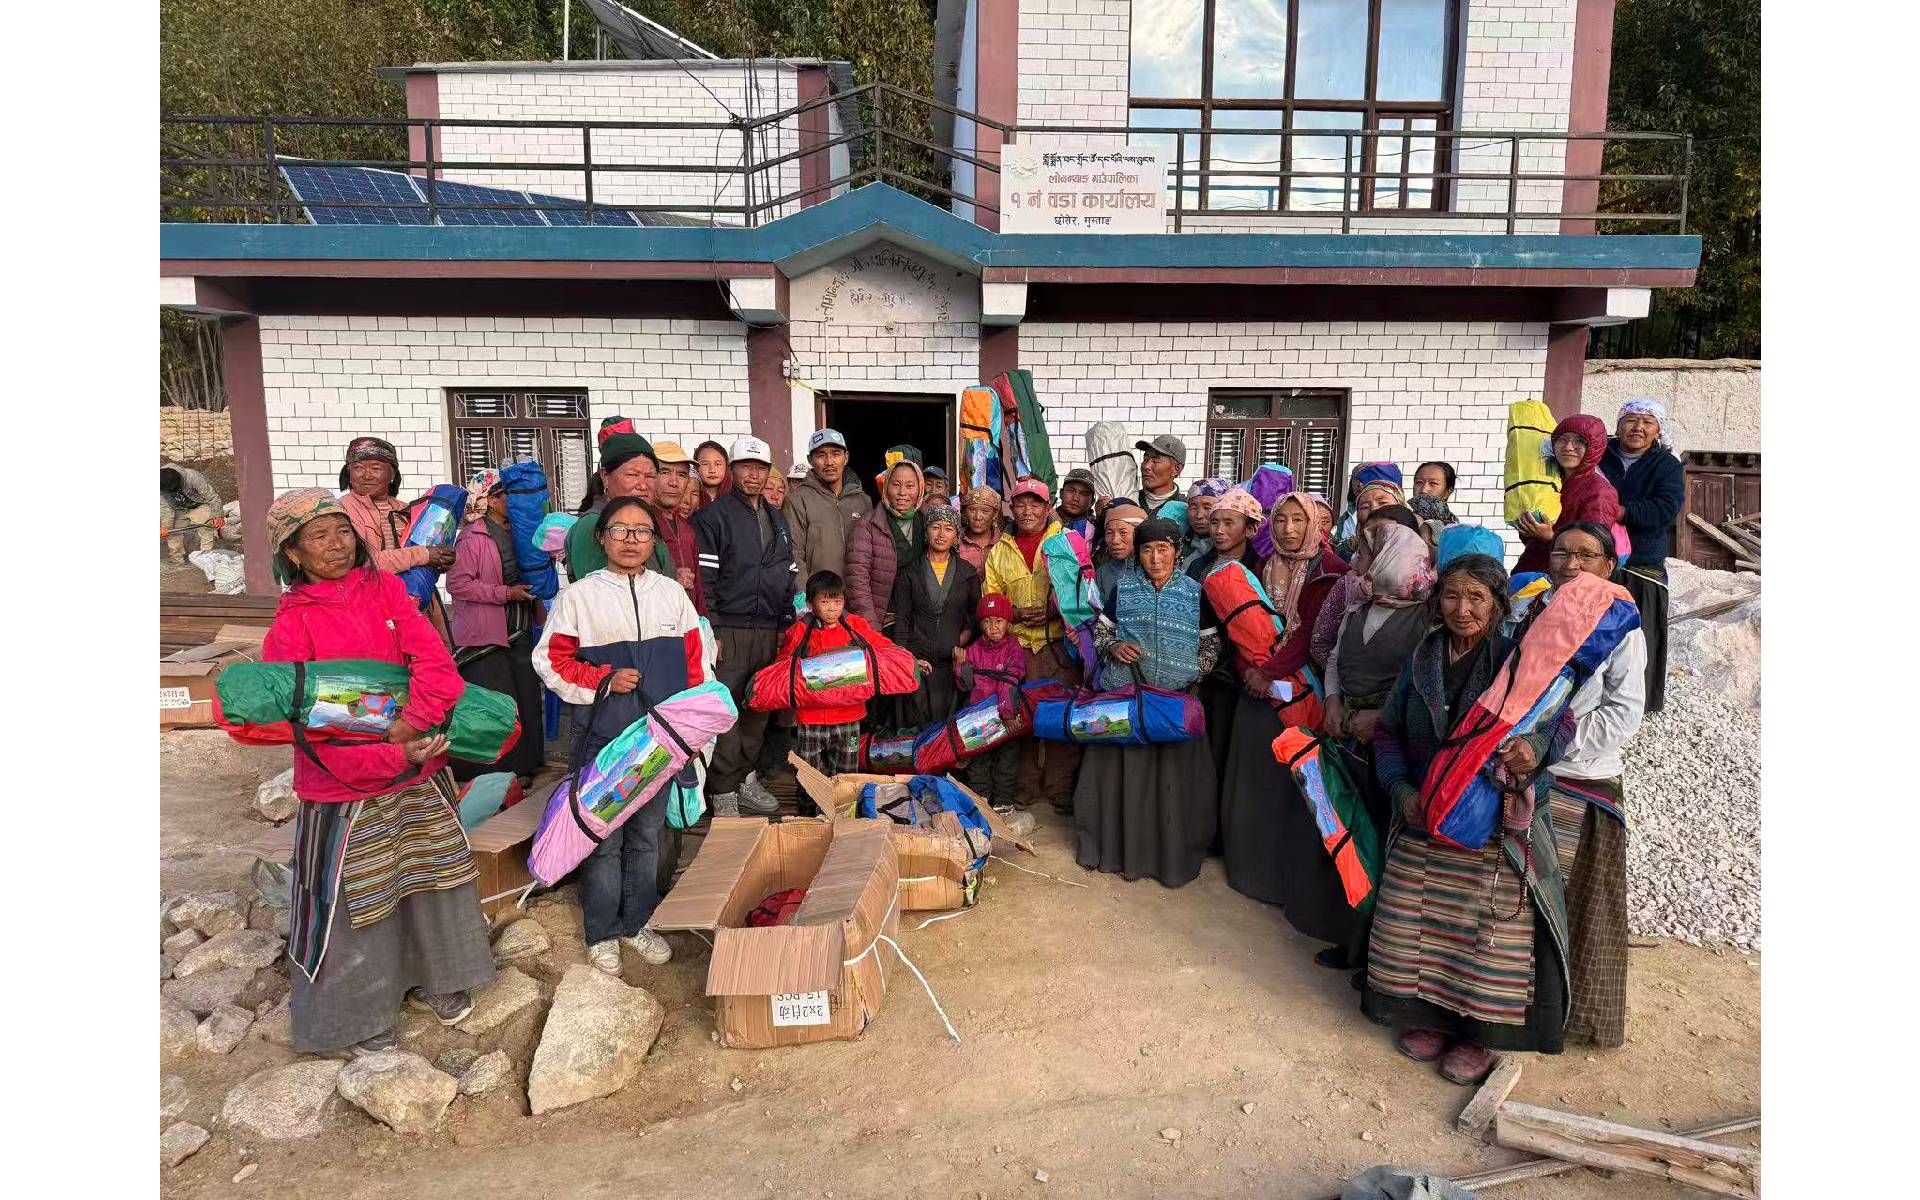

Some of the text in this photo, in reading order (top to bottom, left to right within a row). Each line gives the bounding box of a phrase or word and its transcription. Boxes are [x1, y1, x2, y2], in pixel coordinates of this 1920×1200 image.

[1010, 192, 1022, 209] १
[1047, 192, 1078, 209] वडा
[1082, 189, 1156, 209] कार्यालय
